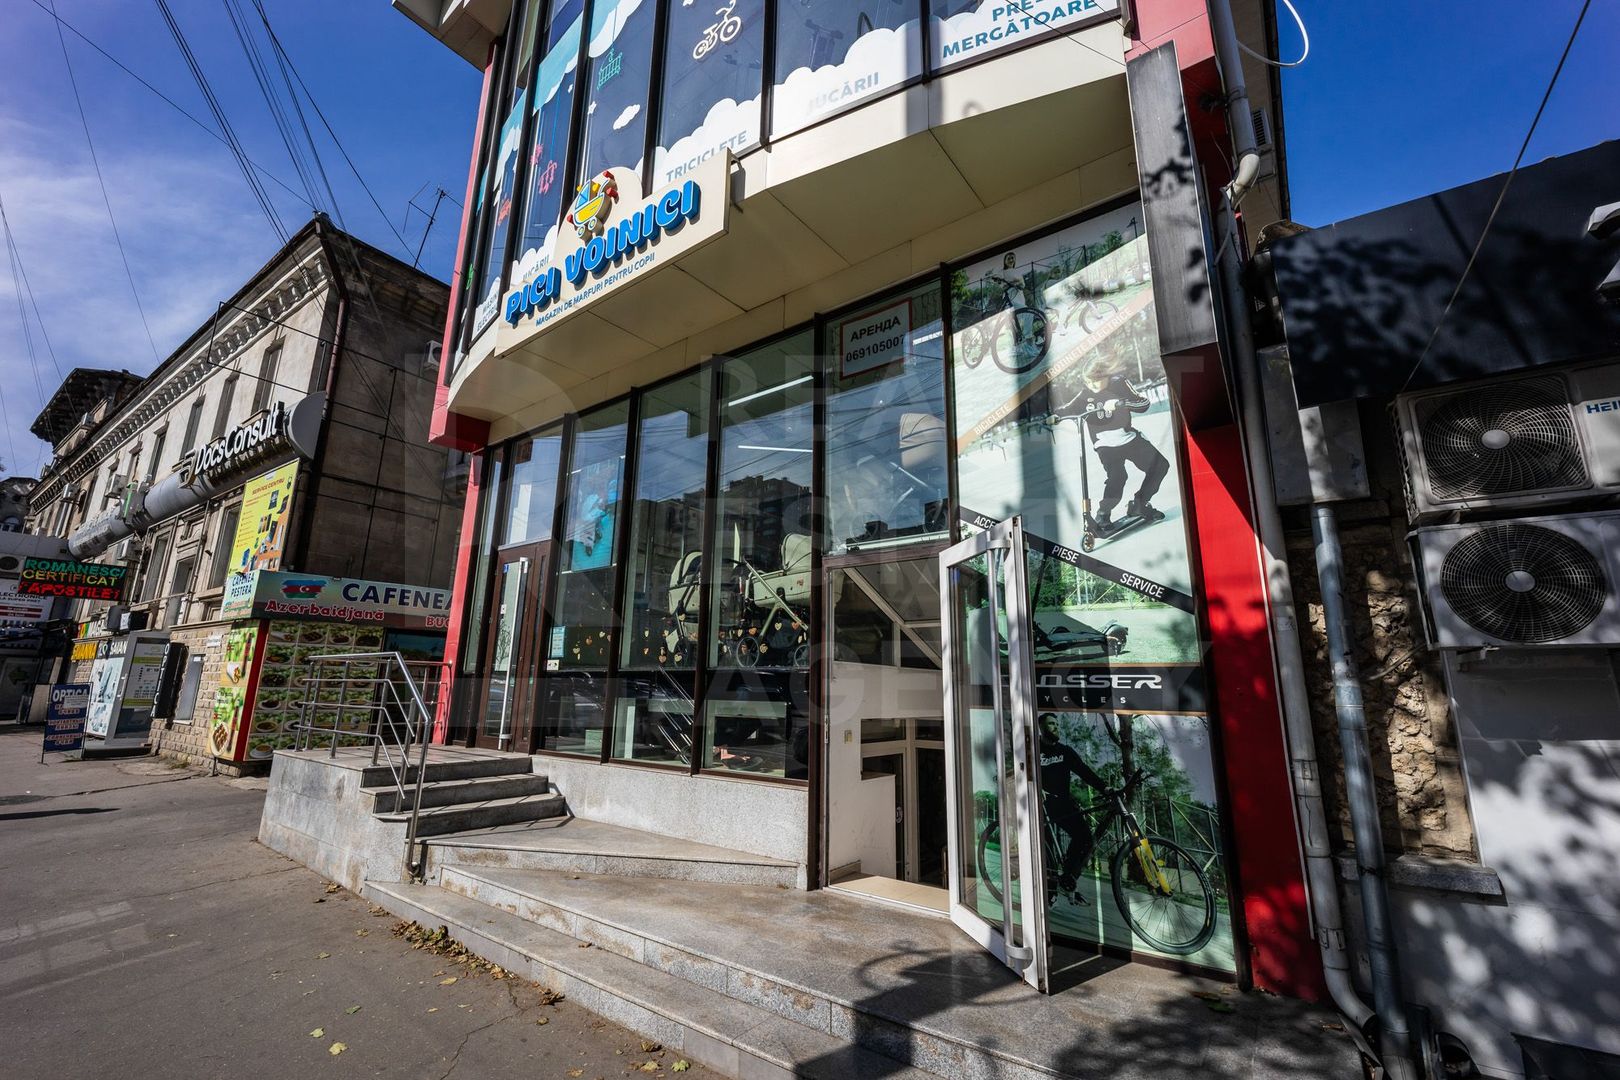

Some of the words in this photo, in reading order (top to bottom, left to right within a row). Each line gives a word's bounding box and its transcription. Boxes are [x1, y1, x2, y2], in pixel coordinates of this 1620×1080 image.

[808, 72, 879, 113] JUCĂRII
[505, 267, 559, 326] PICI
[565, 180, 698, 286] VOINICI
[536, 305, 563, 328] MAGAZIN
[564, 297, 574, 310] DE
[573, 282, 604, 307] MARFURI
[604, 266, 634, 290] PENTRU
[634, 252, 656, 272] COPII
[851, 316, 901, 342] АРЕНДА
[974, 403, 1012, 435] BICICLETE
[1586, 401, 1620, 413] HEI
[195, 400, 280, 476] DocsConsult
[23, 569, 118, 587] CERTIFICAT
[1051, 544, 1079, 563] PIESE
[1120, 573, 1164, 598] SERVICE
[265, 600, 385, 621] Azerbaidjană
[150, 643, 170, 717] OPTICA
